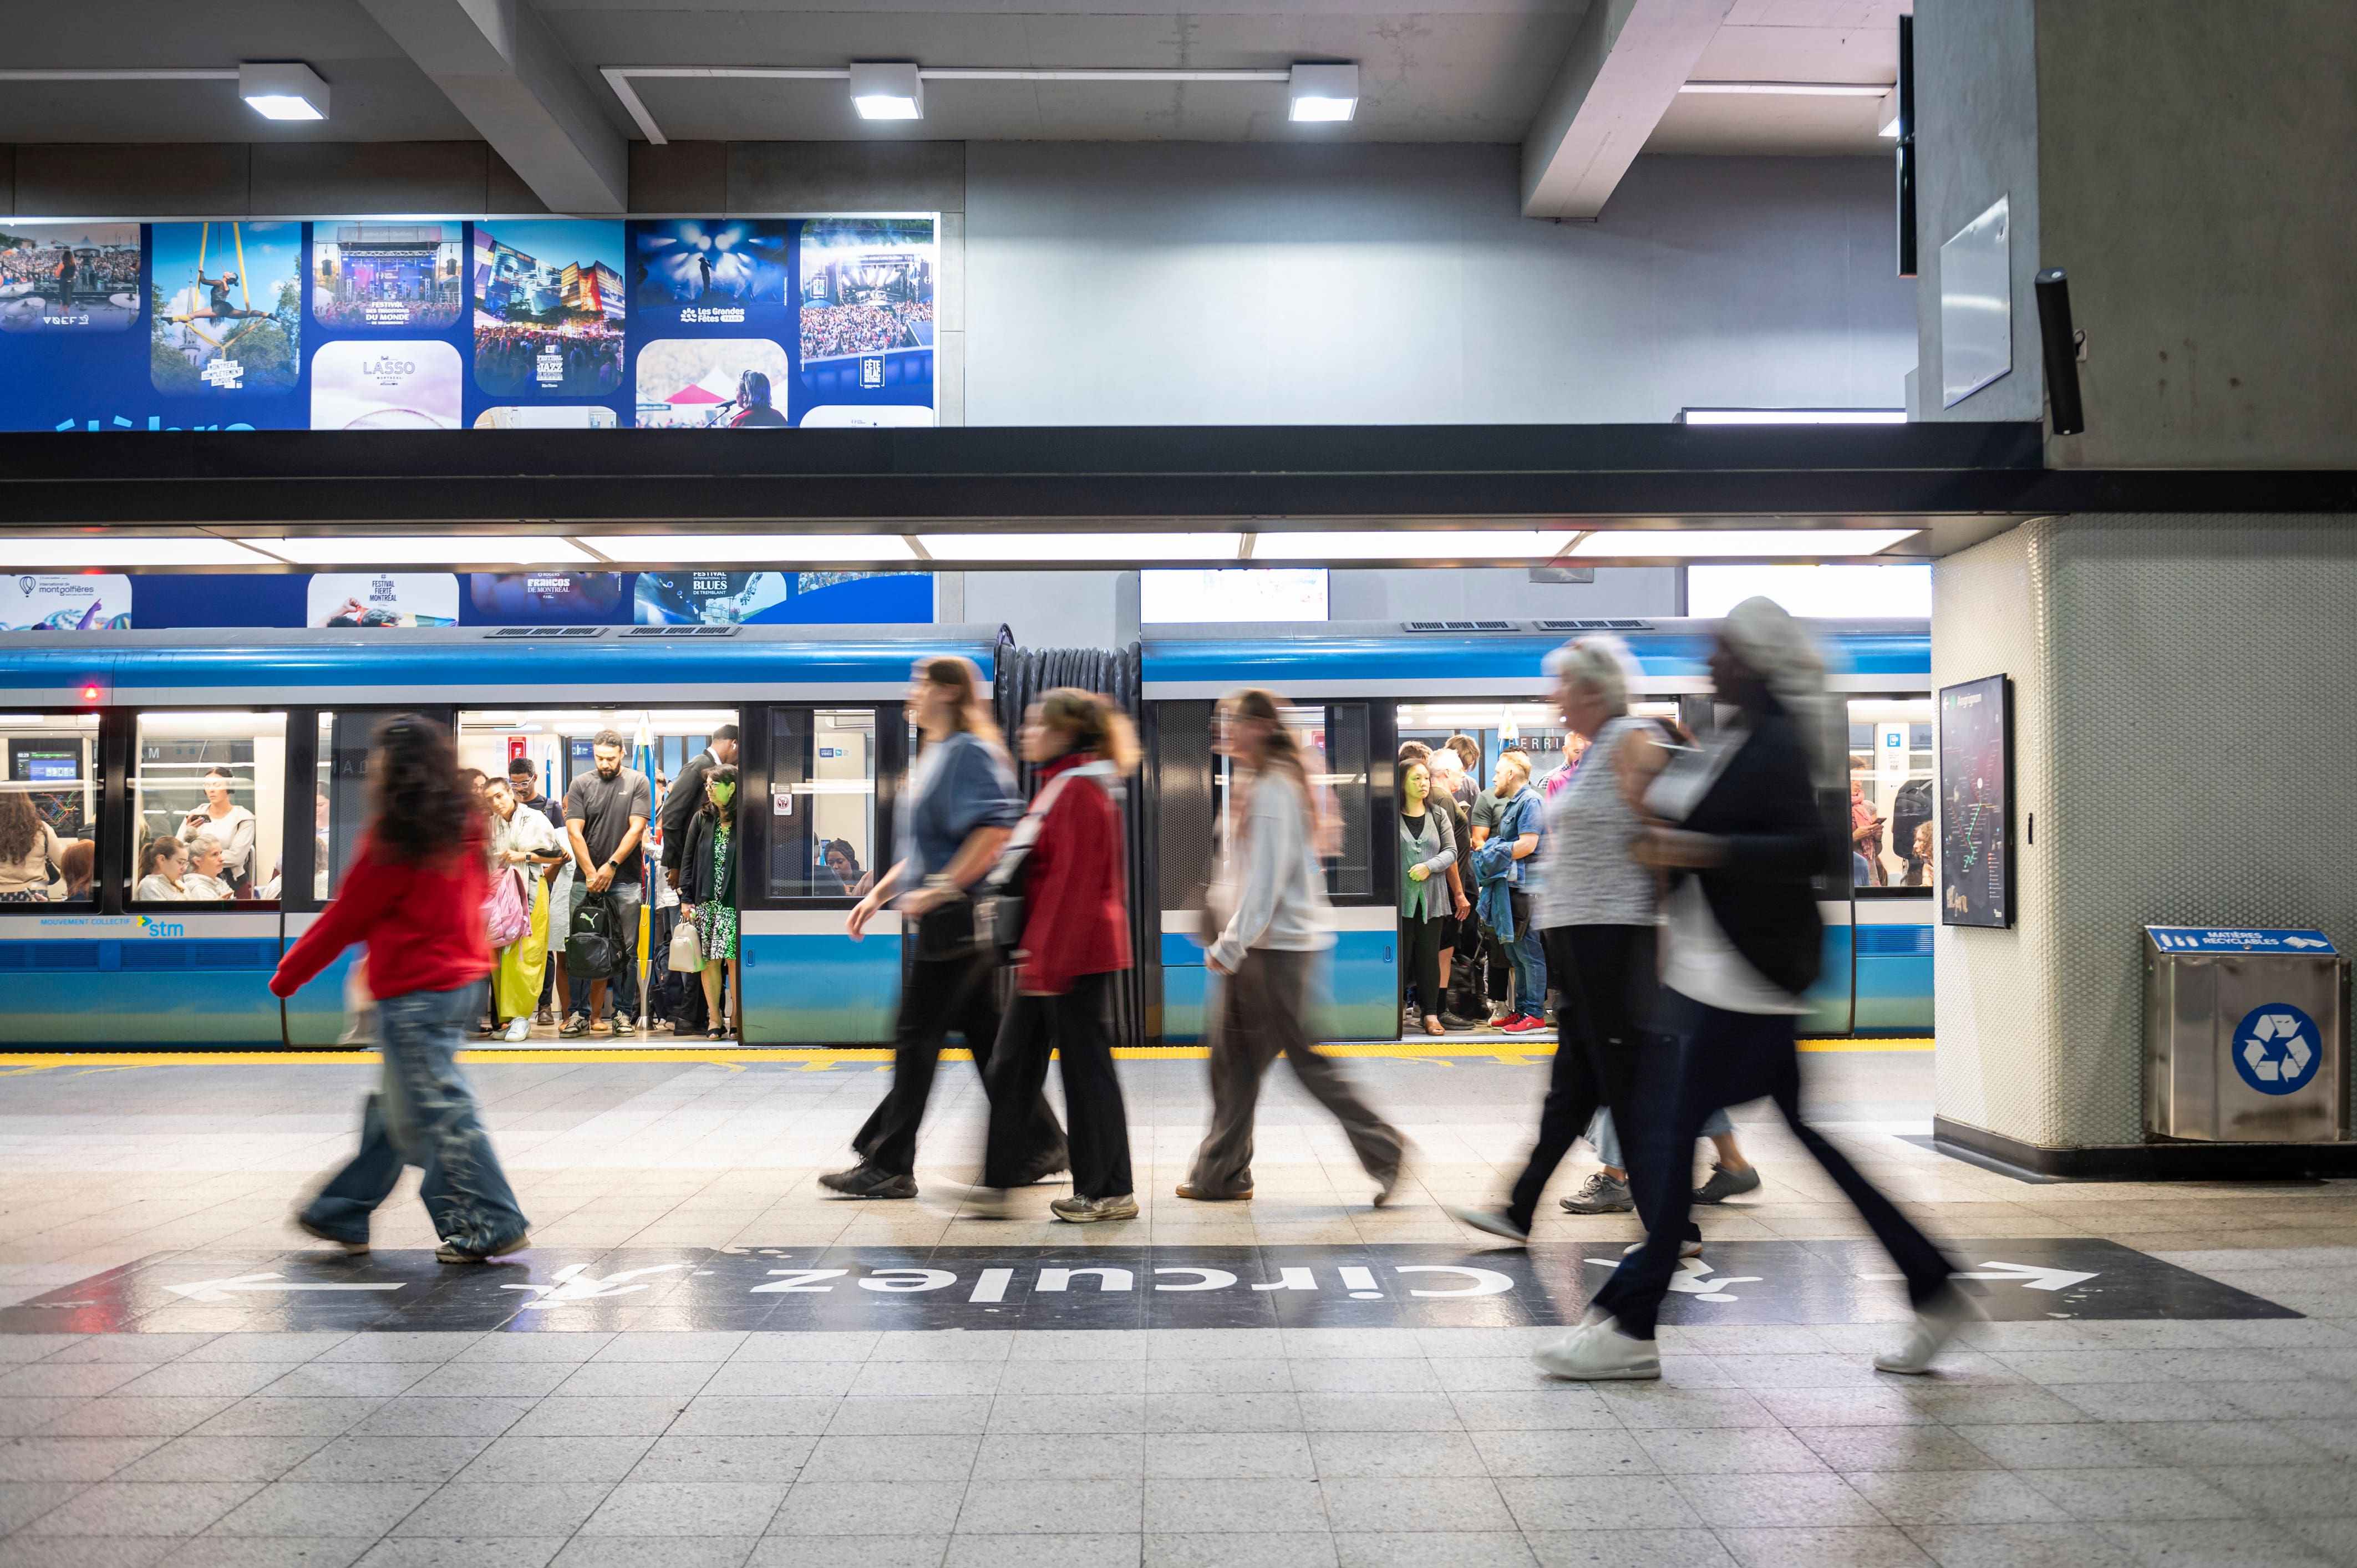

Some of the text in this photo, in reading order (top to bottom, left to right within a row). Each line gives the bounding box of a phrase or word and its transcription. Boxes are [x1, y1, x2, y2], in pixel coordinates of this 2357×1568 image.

[363, 361, 415, 375] LASSO
[537, 363, 563, 372] JAZZ
[864, 358, 881, 369] FÊTE
[870, 369, 881, 378] LAC
[693, 581, 728, 590] BLUES
[39, 586, 94, 596] montgolfières
[149, 920, 184, 936] stm
[749, 1265, 1515, 1302] Circulez
